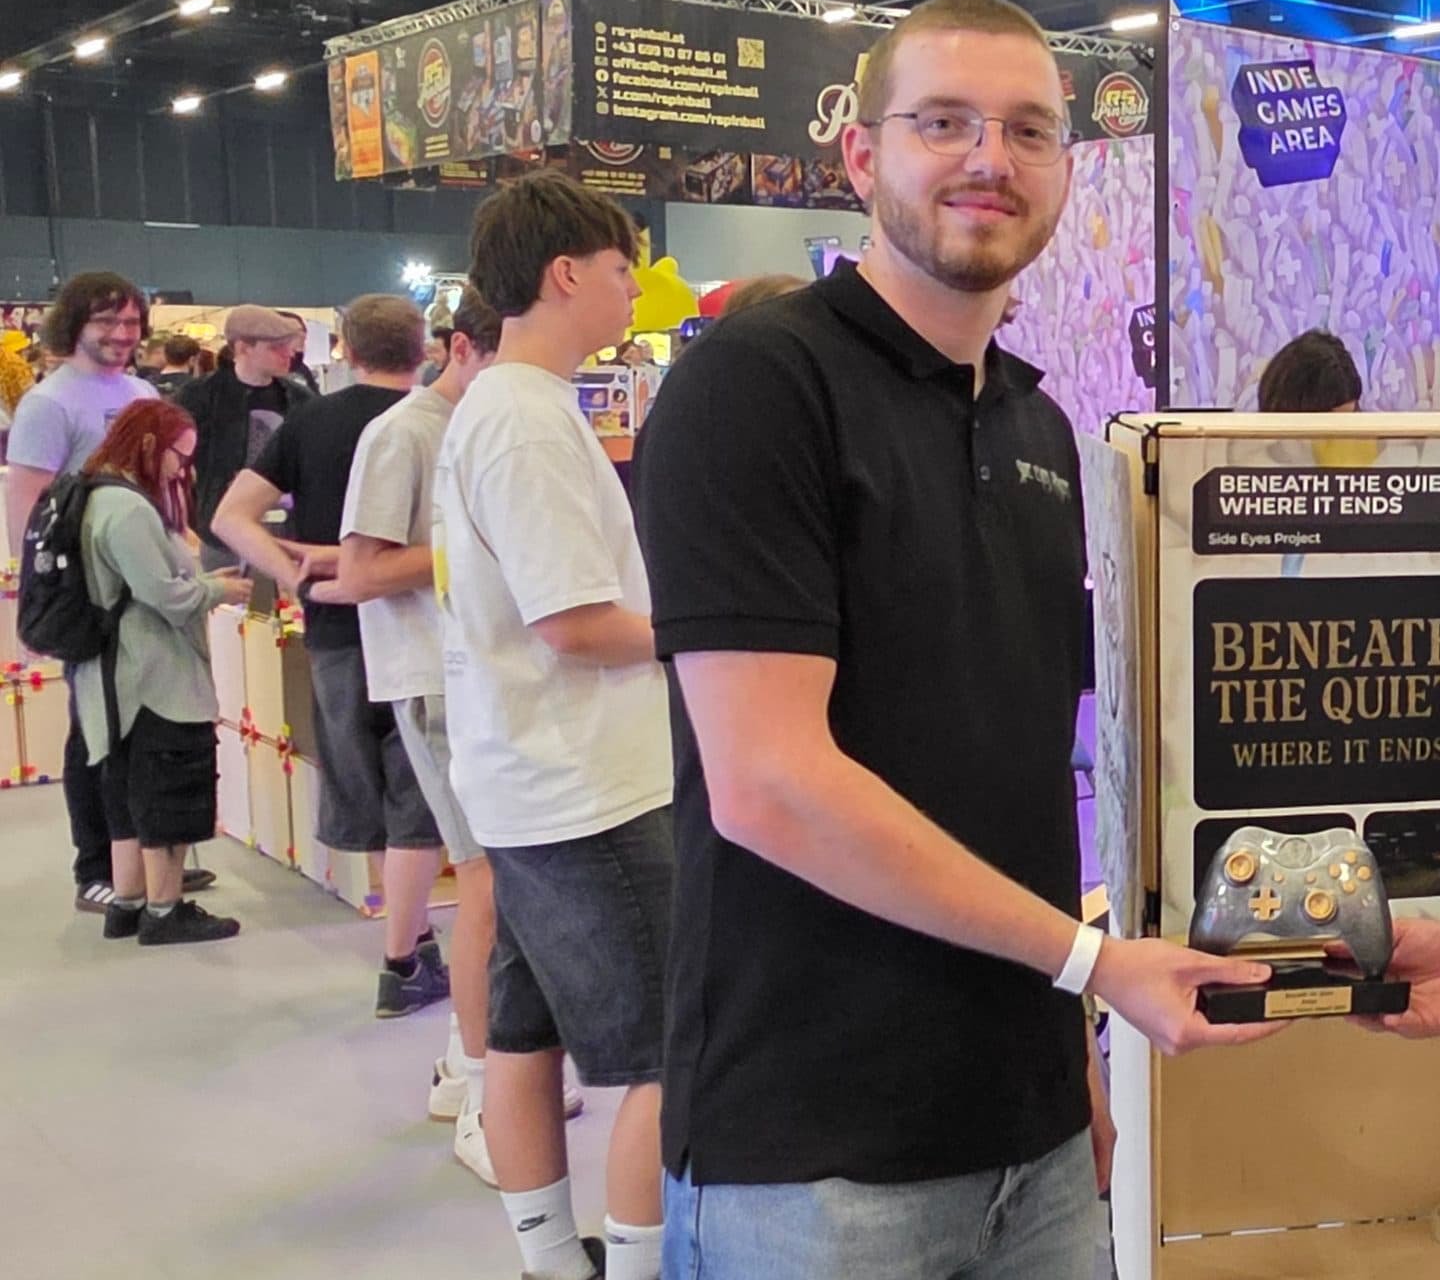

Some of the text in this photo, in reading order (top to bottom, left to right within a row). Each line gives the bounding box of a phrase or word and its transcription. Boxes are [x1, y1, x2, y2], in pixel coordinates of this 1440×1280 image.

[612, 71, 760, 99] facebook.com/rspinball
[1246, 66, 1317, 95] INDIE
[1257, 93, 1342, 125] GAMES
[1271, 125, 1336, 155] AREA
[1219, 474, 1329, 494] BENEATH
[1335, 474, 1381, 493] THE
[1219, 496, 1403, 516] WHERE IT ENDS
[1208, 531, 1322, 548] Side Eyes Project
[1210, 677, 1308, 724] THE
[1232, 740, 1333, 769] WHERE
[1343, 739, 1370, 765] IT
